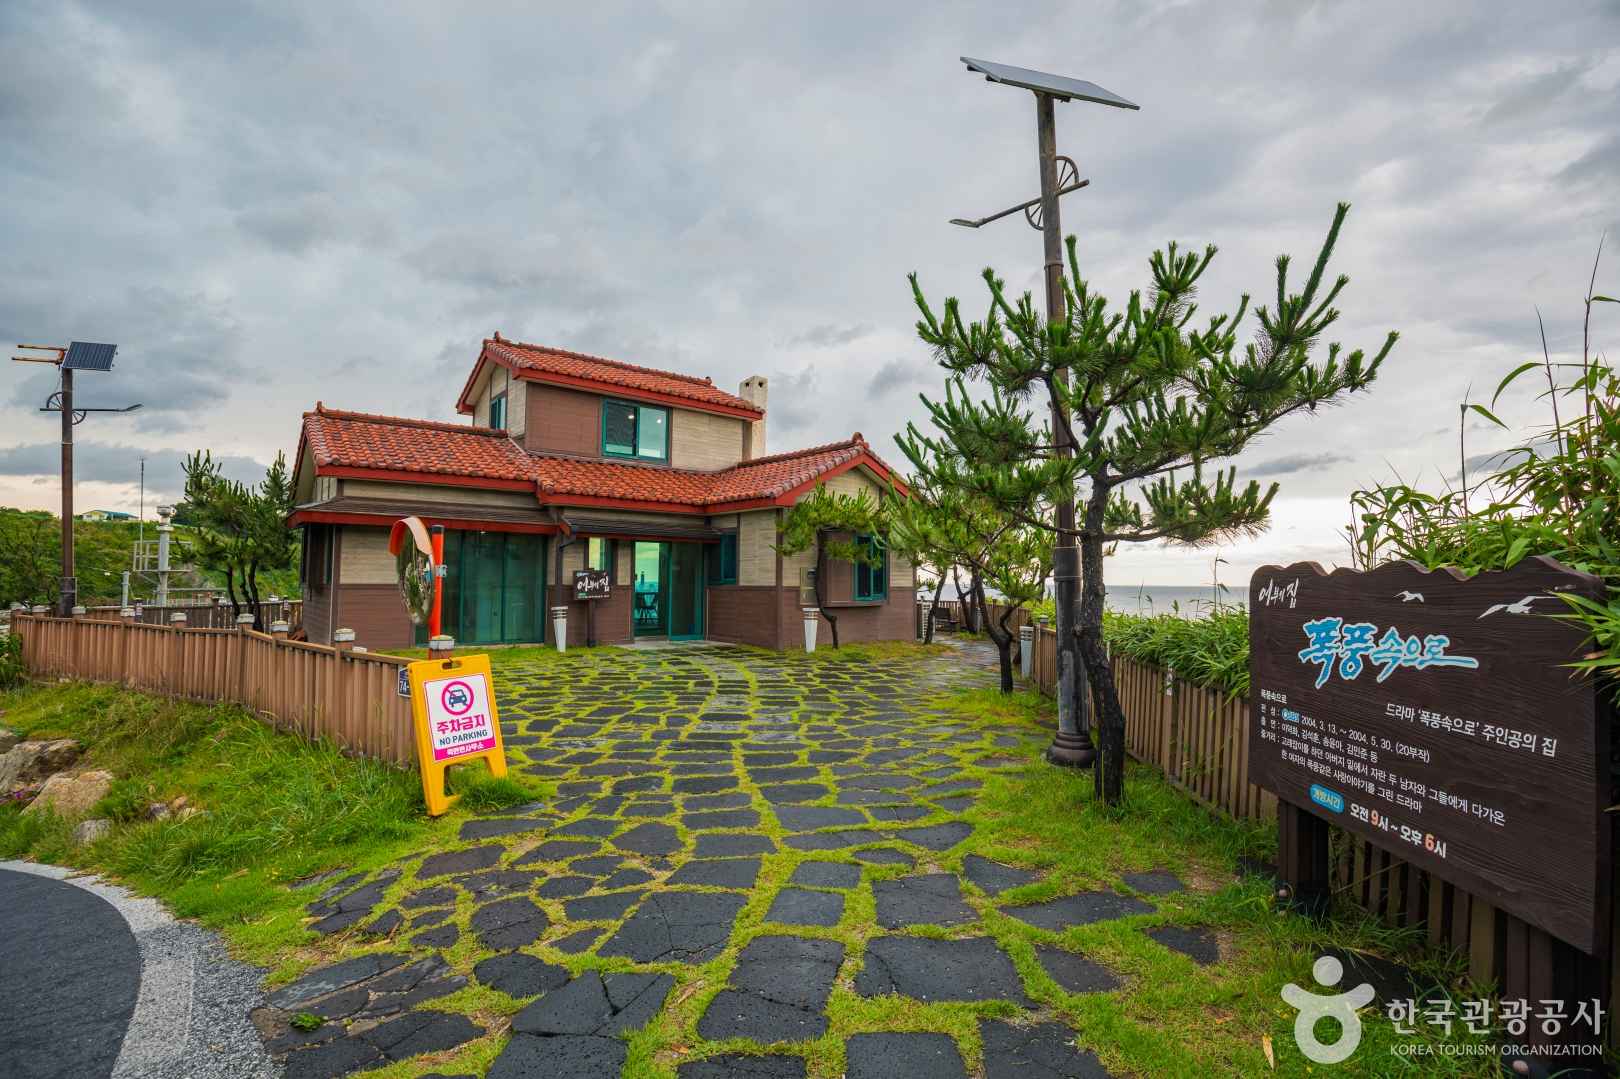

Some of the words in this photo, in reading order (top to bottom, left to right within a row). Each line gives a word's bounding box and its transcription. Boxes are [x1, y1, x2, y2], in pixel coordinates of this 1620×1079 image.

[600, 576, 609, 592] 집
[1286, 578, 1299, 608] 집
[1261, 689, 1287, 704] 폭풍속으로
[436, 713, 485, 734] 주차금지
[439, 736, 450, 745] NO
[453, 729, 488, 743] PARKING
[1384, 703, 1415, 722] 드라마
[1482, 724, 1537, 753] 주인공의
[1541, 737, 1557, 758] 집
[1347, 743, 1368, 760] 김민준
[1371, 750, 1377, 763] 등
[1348, 729, 1369, 745] 2004.
[1371, 735, 1378, 748] 5.
[1380, 738, 1393, 752] 30.
[1395, 741, 1430, 763] (20부작)
[1281, 736, 1309, 754] 고래잡이를
[1311, 746, 1324, 760] 하던
[1325, 752, 1345, 767] 아버지
[1347, 759, 1368, 776] 밑에서
[1370, 767, 1386, 783] 자란
[1389, 773, 1397, 786] 두
[1400, 777, 1427, 798] 남자와
[1428, 788, 1468, 814] 그들에게
[1471, 803, 1506, 827] 다가온
[1289, 752, 1305, 767] 여자의
[1333, 769, 1375, 794] 사랑이야기를
[1377, 787, 1393, 802] 그린
[1396, 794, 1422, 814] 드라마
[1350, 803, 1369, 823] 오전
[1370, 809, 1389, 831] 9시
[1400, 824, 1422, 846] 오후
[1424, 833, 1447, 859] 6시
